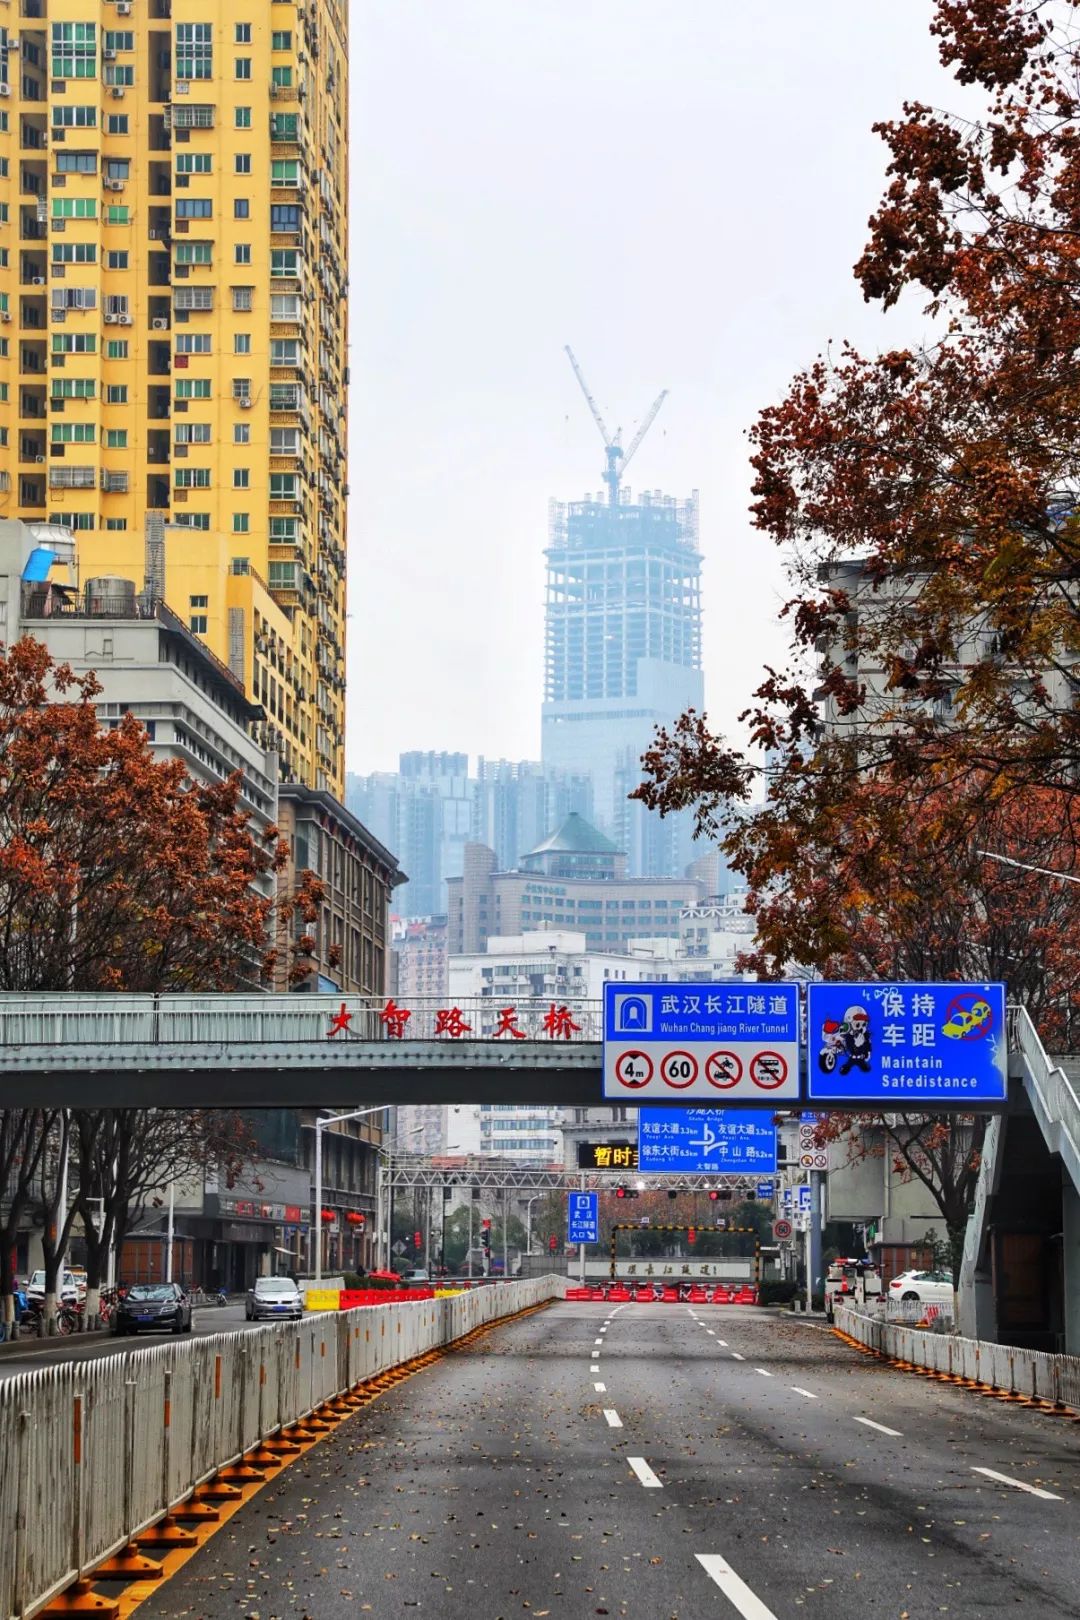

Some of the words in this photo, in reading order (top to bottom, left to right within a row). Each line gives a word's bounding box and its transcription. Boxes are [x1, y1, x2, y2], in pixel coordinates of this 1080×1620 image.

[660, 994, 788, 1015] 武汉长江隧道
[881, 993, 935, 1018] 保持
[326, 999, 582, 1039] 大智路天桥
[660, 1023, 688, 1033] Wuhan
[690, 1022, 715, 1035] Chang
[717, 1022, 737, 1036] jiang
[739, 1023, 759, 1033] River
[761, 1023, 789, 1034] Tunnel
[882, 1023, 936, 1047] 车距
[668, 1060, 691, 1078] 60
[881, 1055, 943, 1069] Maintain
[624, 1062, 644, 1078] 4m
[882, 1074, 978, 1088] Safedistance
[642, 1123, 680, 1134] 友谊大道
[718, 1123, 755, 1135] 友谊大道
[642, 1145, 680, 1156] 徐东大街
[719, 1146, 756, 1157] 中山路
[696, 1163, 719, 1171] 大智路
[571, 1231, 585, 1239] 入口
